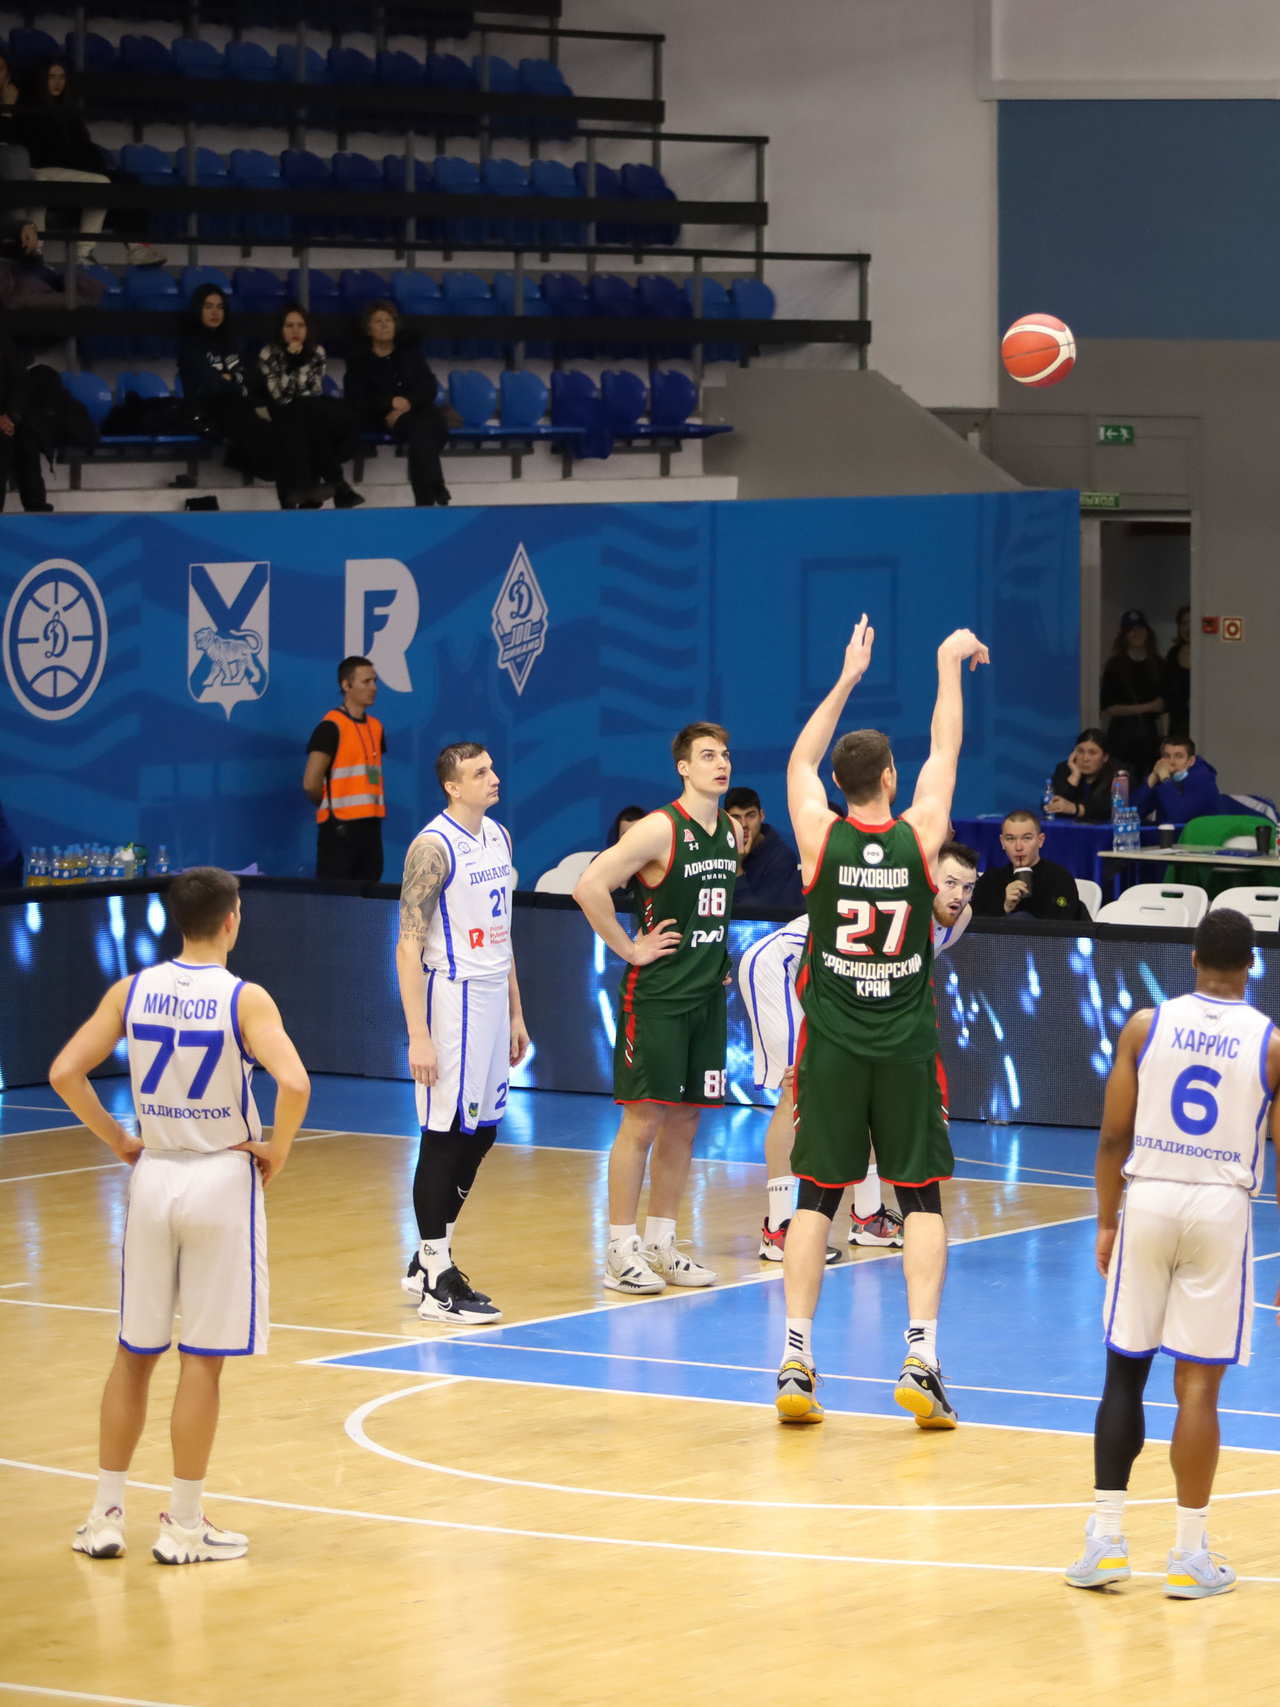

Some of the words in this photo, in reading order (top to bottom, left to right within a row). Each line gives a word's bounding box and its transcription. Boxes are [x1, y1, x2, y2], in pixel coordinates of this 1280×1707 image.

[684, 859, 737, 878] ЛОКОМОТИВ
[838, 865, 909, 889] ШУХОВЦОВ
[489, 886, 508, 918] 21
[697, 887, 727, 917] 88
[836, 899, 912, 956] 27
[856, 979, 891, 997] КРАЙ
[1171, 1026, 1241, 1059] ХАРРИС
[132, 1022, 225, 1100] 77
[1170, 1064, 1223, 1136] 6
[1135, 1135, 1242, 1164] ВЛАДИВОСТОК
